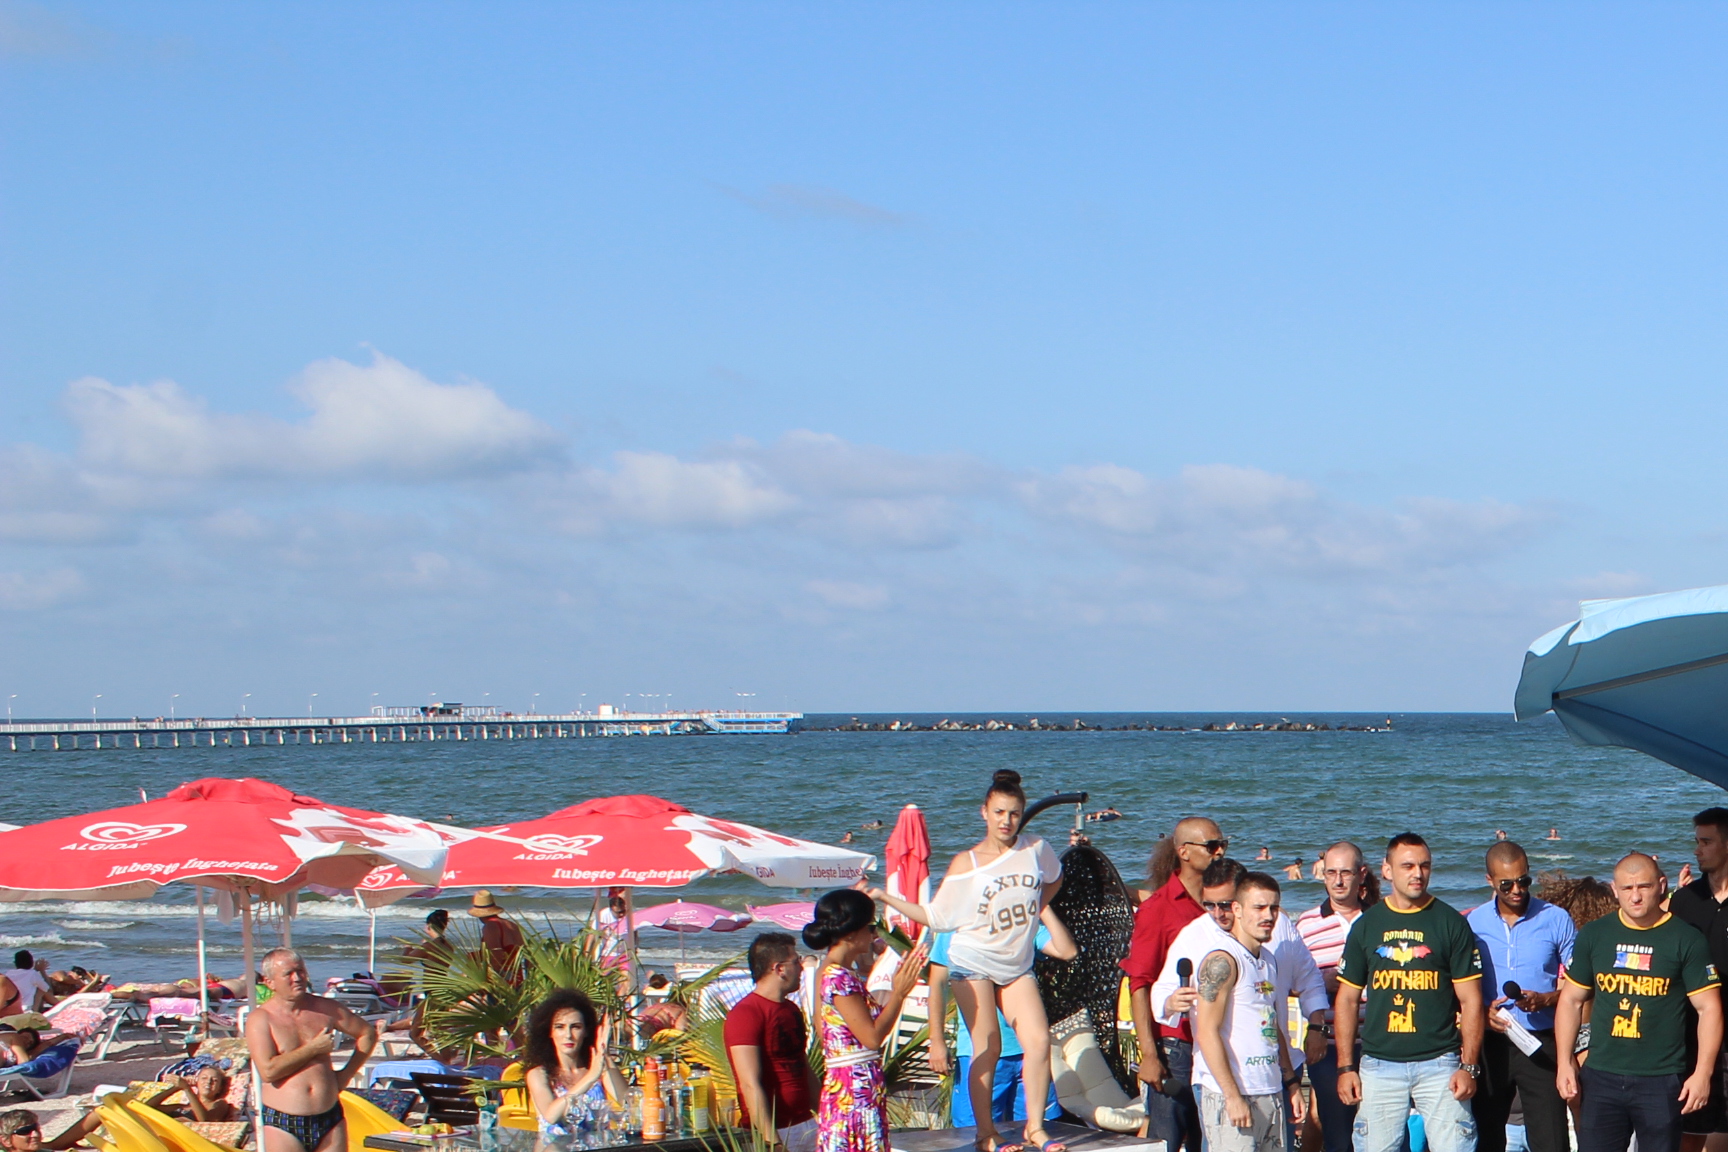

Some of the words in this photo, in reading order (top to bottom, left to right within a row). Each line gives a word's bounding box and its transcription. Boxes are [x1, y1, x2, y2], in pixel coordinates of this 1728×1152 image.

[60, 842, 139, 851] ALGIDA
[513, 853, 574, 861] ALGIDA
[1372, 970, 1438, 990] COTNARI
